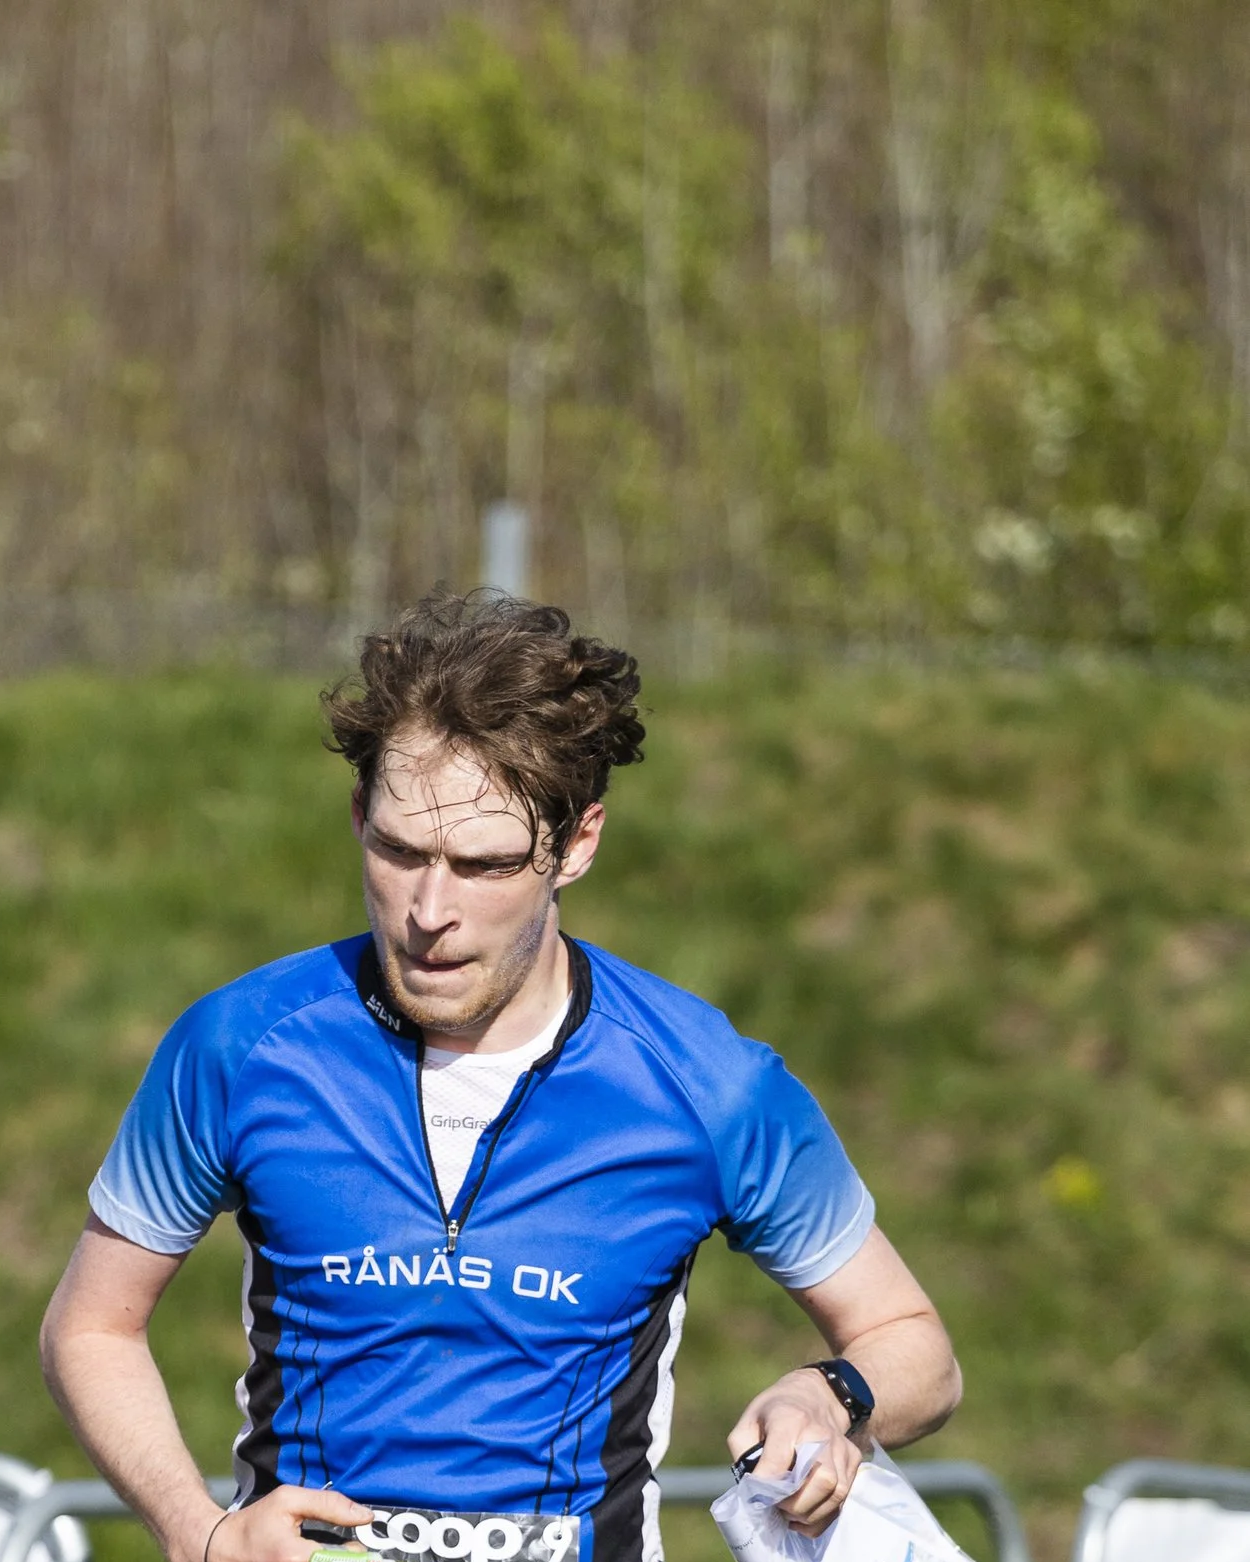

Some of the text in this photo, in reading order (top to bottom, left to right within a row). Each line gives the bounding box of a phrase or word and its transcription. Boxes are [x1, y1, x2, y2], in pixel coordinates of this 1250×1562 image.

[430, 1114, 493, 1131] GripGra
[321, 1245, 583, 1304] RÅNÄS OK
